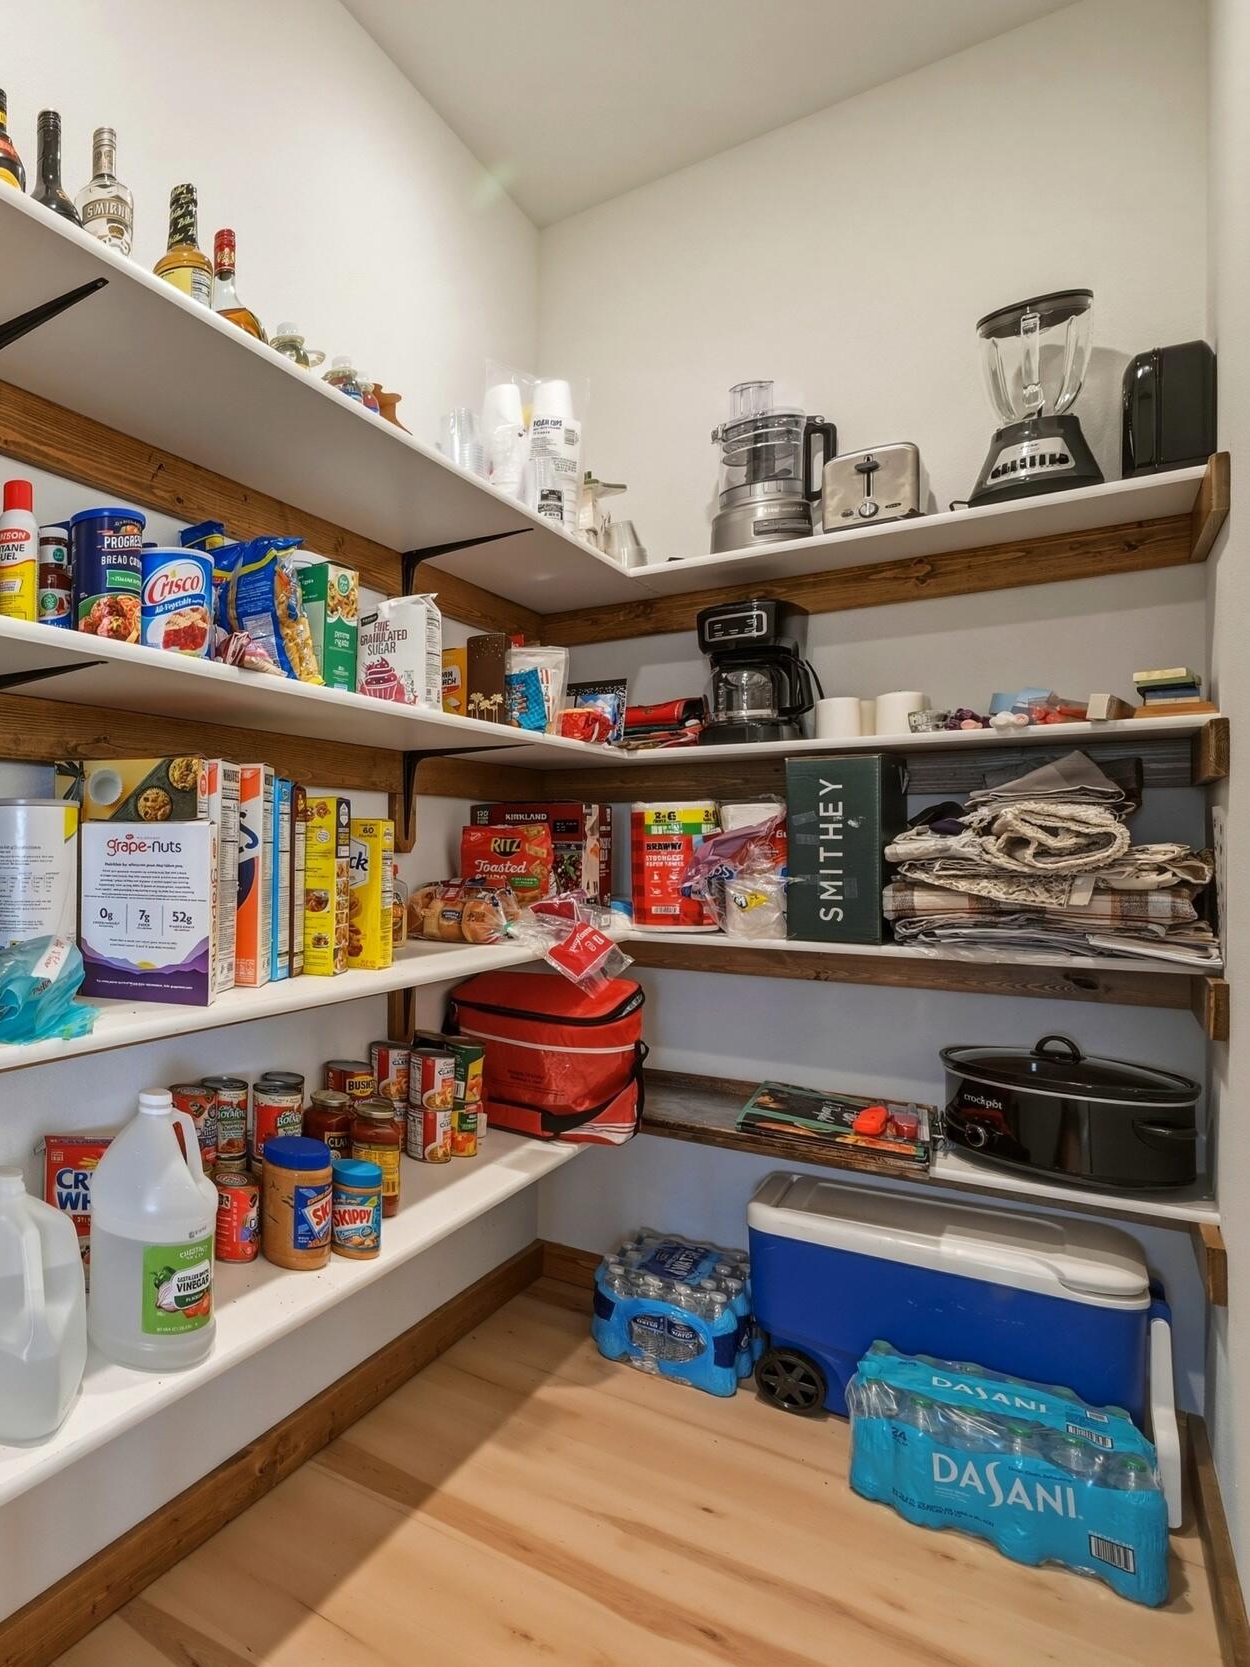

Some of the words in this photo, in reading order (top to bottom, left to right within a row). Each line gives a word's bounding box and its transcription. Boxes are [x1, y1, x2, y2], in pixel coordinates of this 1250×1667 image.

[101, 555, 128, 565] BREAD
[148, 574, 200, 605] Crisco
[373, 620, 390, 633] FINE
[360, 629, 408, 646] GRANULATED
[367, 641, 397, 657] SUGAR
[505, 813, 547, 821] KIRKLAND
[106, 838, 182, 857] grape-nuts
[490, 837, 522, 853] RITZ
[819, 778, 844, 922] SMITHEY
[474, 859, 527, 874] Toasted
[99, 907, 113, 921] 0g
[138, 909, 150, 923] 7g
[172, 911, 193, 925] 52g
[334, 1208, 372, 1227] SKIPPY
[176, 1274, 209, 1293] VINEGAR
[931, 1376, 1047, 1415] DASANI
[931, 1452, 1077, 1520] DASANI
